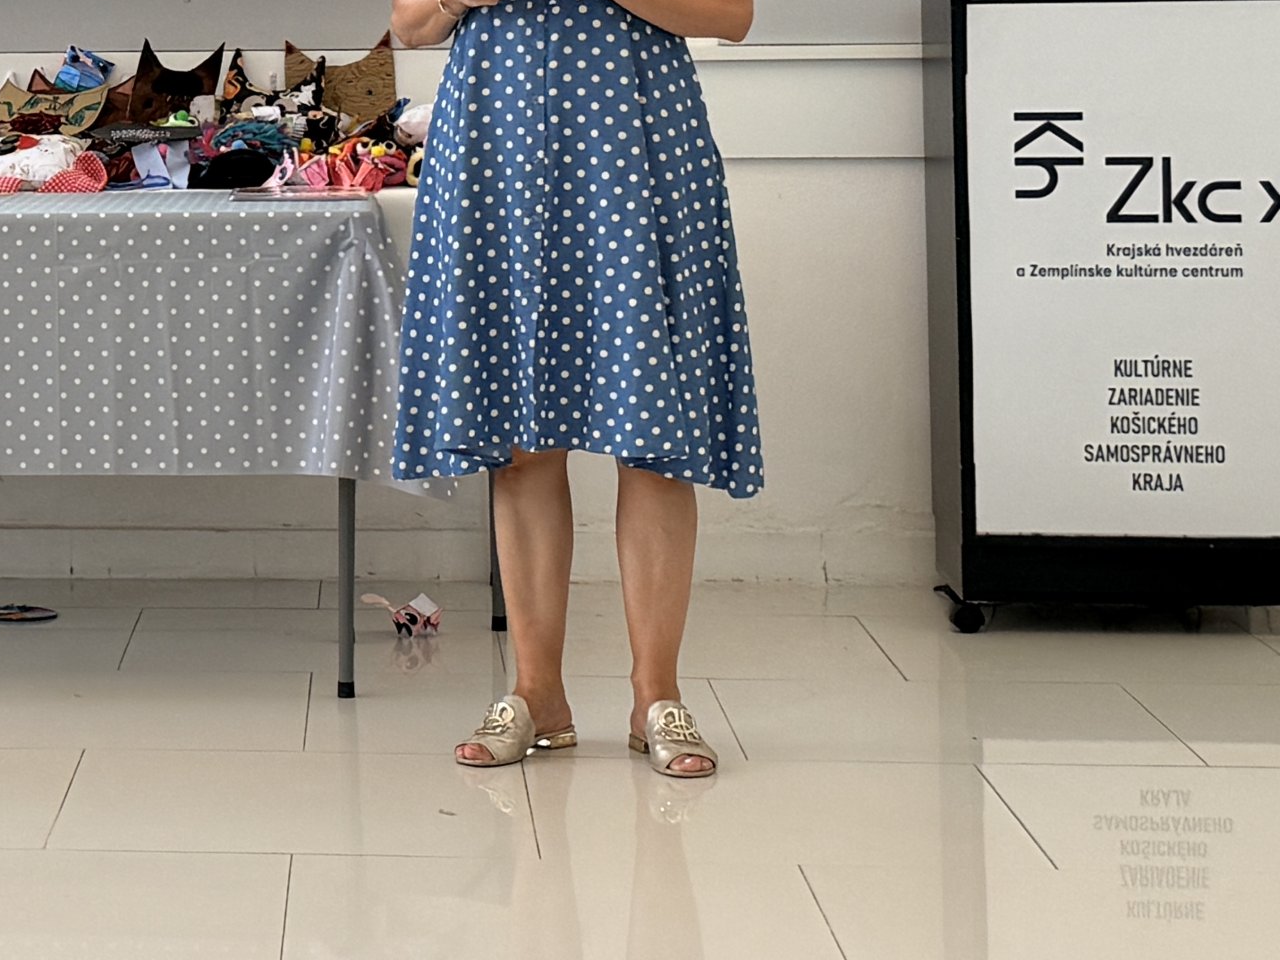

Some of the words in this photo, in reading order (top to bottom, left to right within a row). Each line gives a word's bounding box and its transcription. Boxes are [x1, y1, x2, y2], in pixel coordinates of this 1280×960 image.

[1106, 243, 1161, 259] Krajská
[1165, 243, 1243, 257] hvezdáreň
[1016, 267, 1025, 277] a
[1030, 264, 1112, 280] Zemplínske
[1116, 264, 1178, 277] kultúrne
[1182, 266, 1243, 277] centrum
[1114, 354, 1193, 378] KULTÚRNE
[1108, 388, 1200, 406] ZARIADENIE
[1110, 411, 1198, 435] KOŠICKÉHO
[1084, 440, 1226, 463] SAMOSPRÁVNEHO
[1132, 473, 1184, 492] KRAJA
